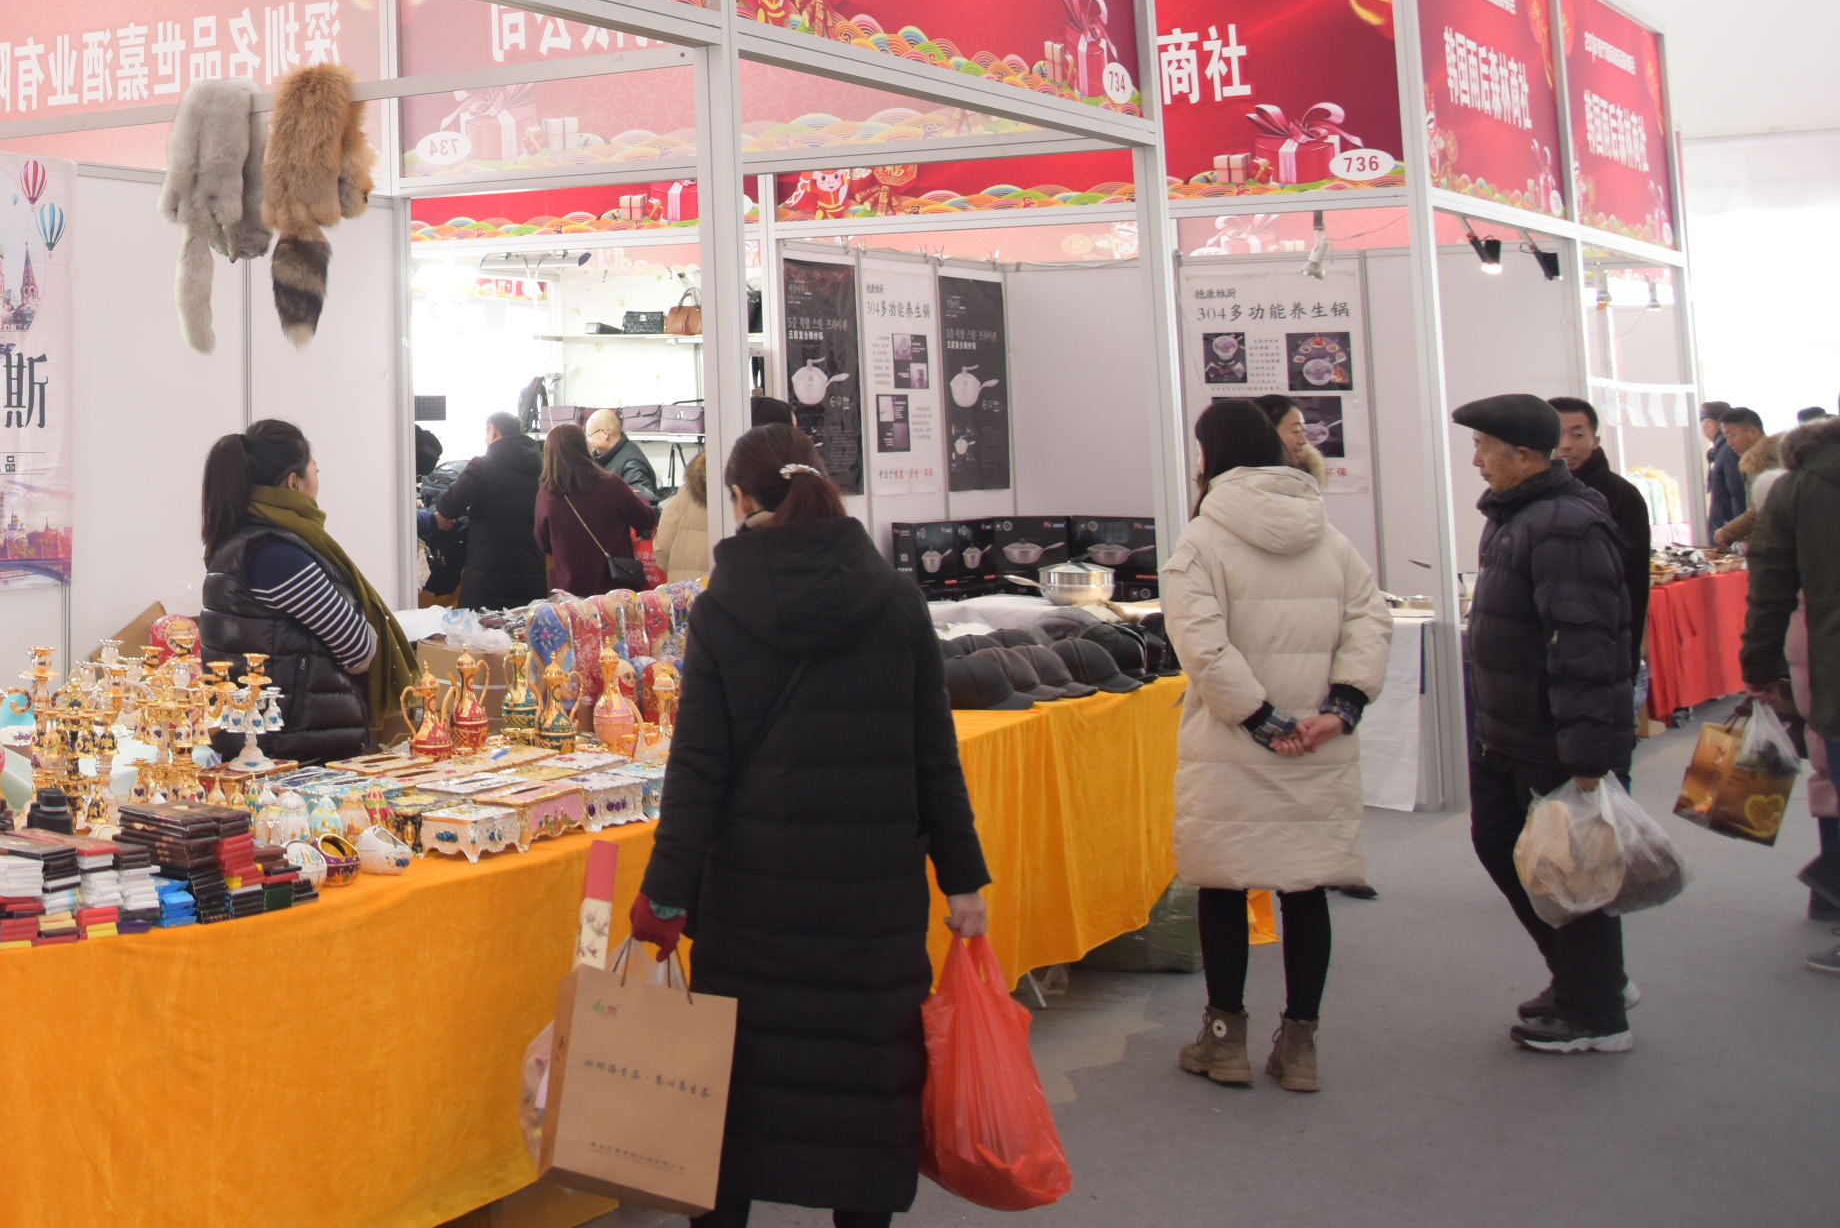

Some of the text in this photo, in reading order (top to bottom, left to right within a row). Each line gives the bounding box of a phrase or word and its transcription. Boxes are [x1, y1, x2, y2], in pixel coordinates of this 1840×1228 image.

[1156, 23, 1252, 105] 商社
[1108, 69, 1127, 95] 734
[1342, 153, 1380, 174] 736
[866, 299, 931, 320] 304多功能养生锅
[1196, 301, 1350, 321] 304多功能养生锅
